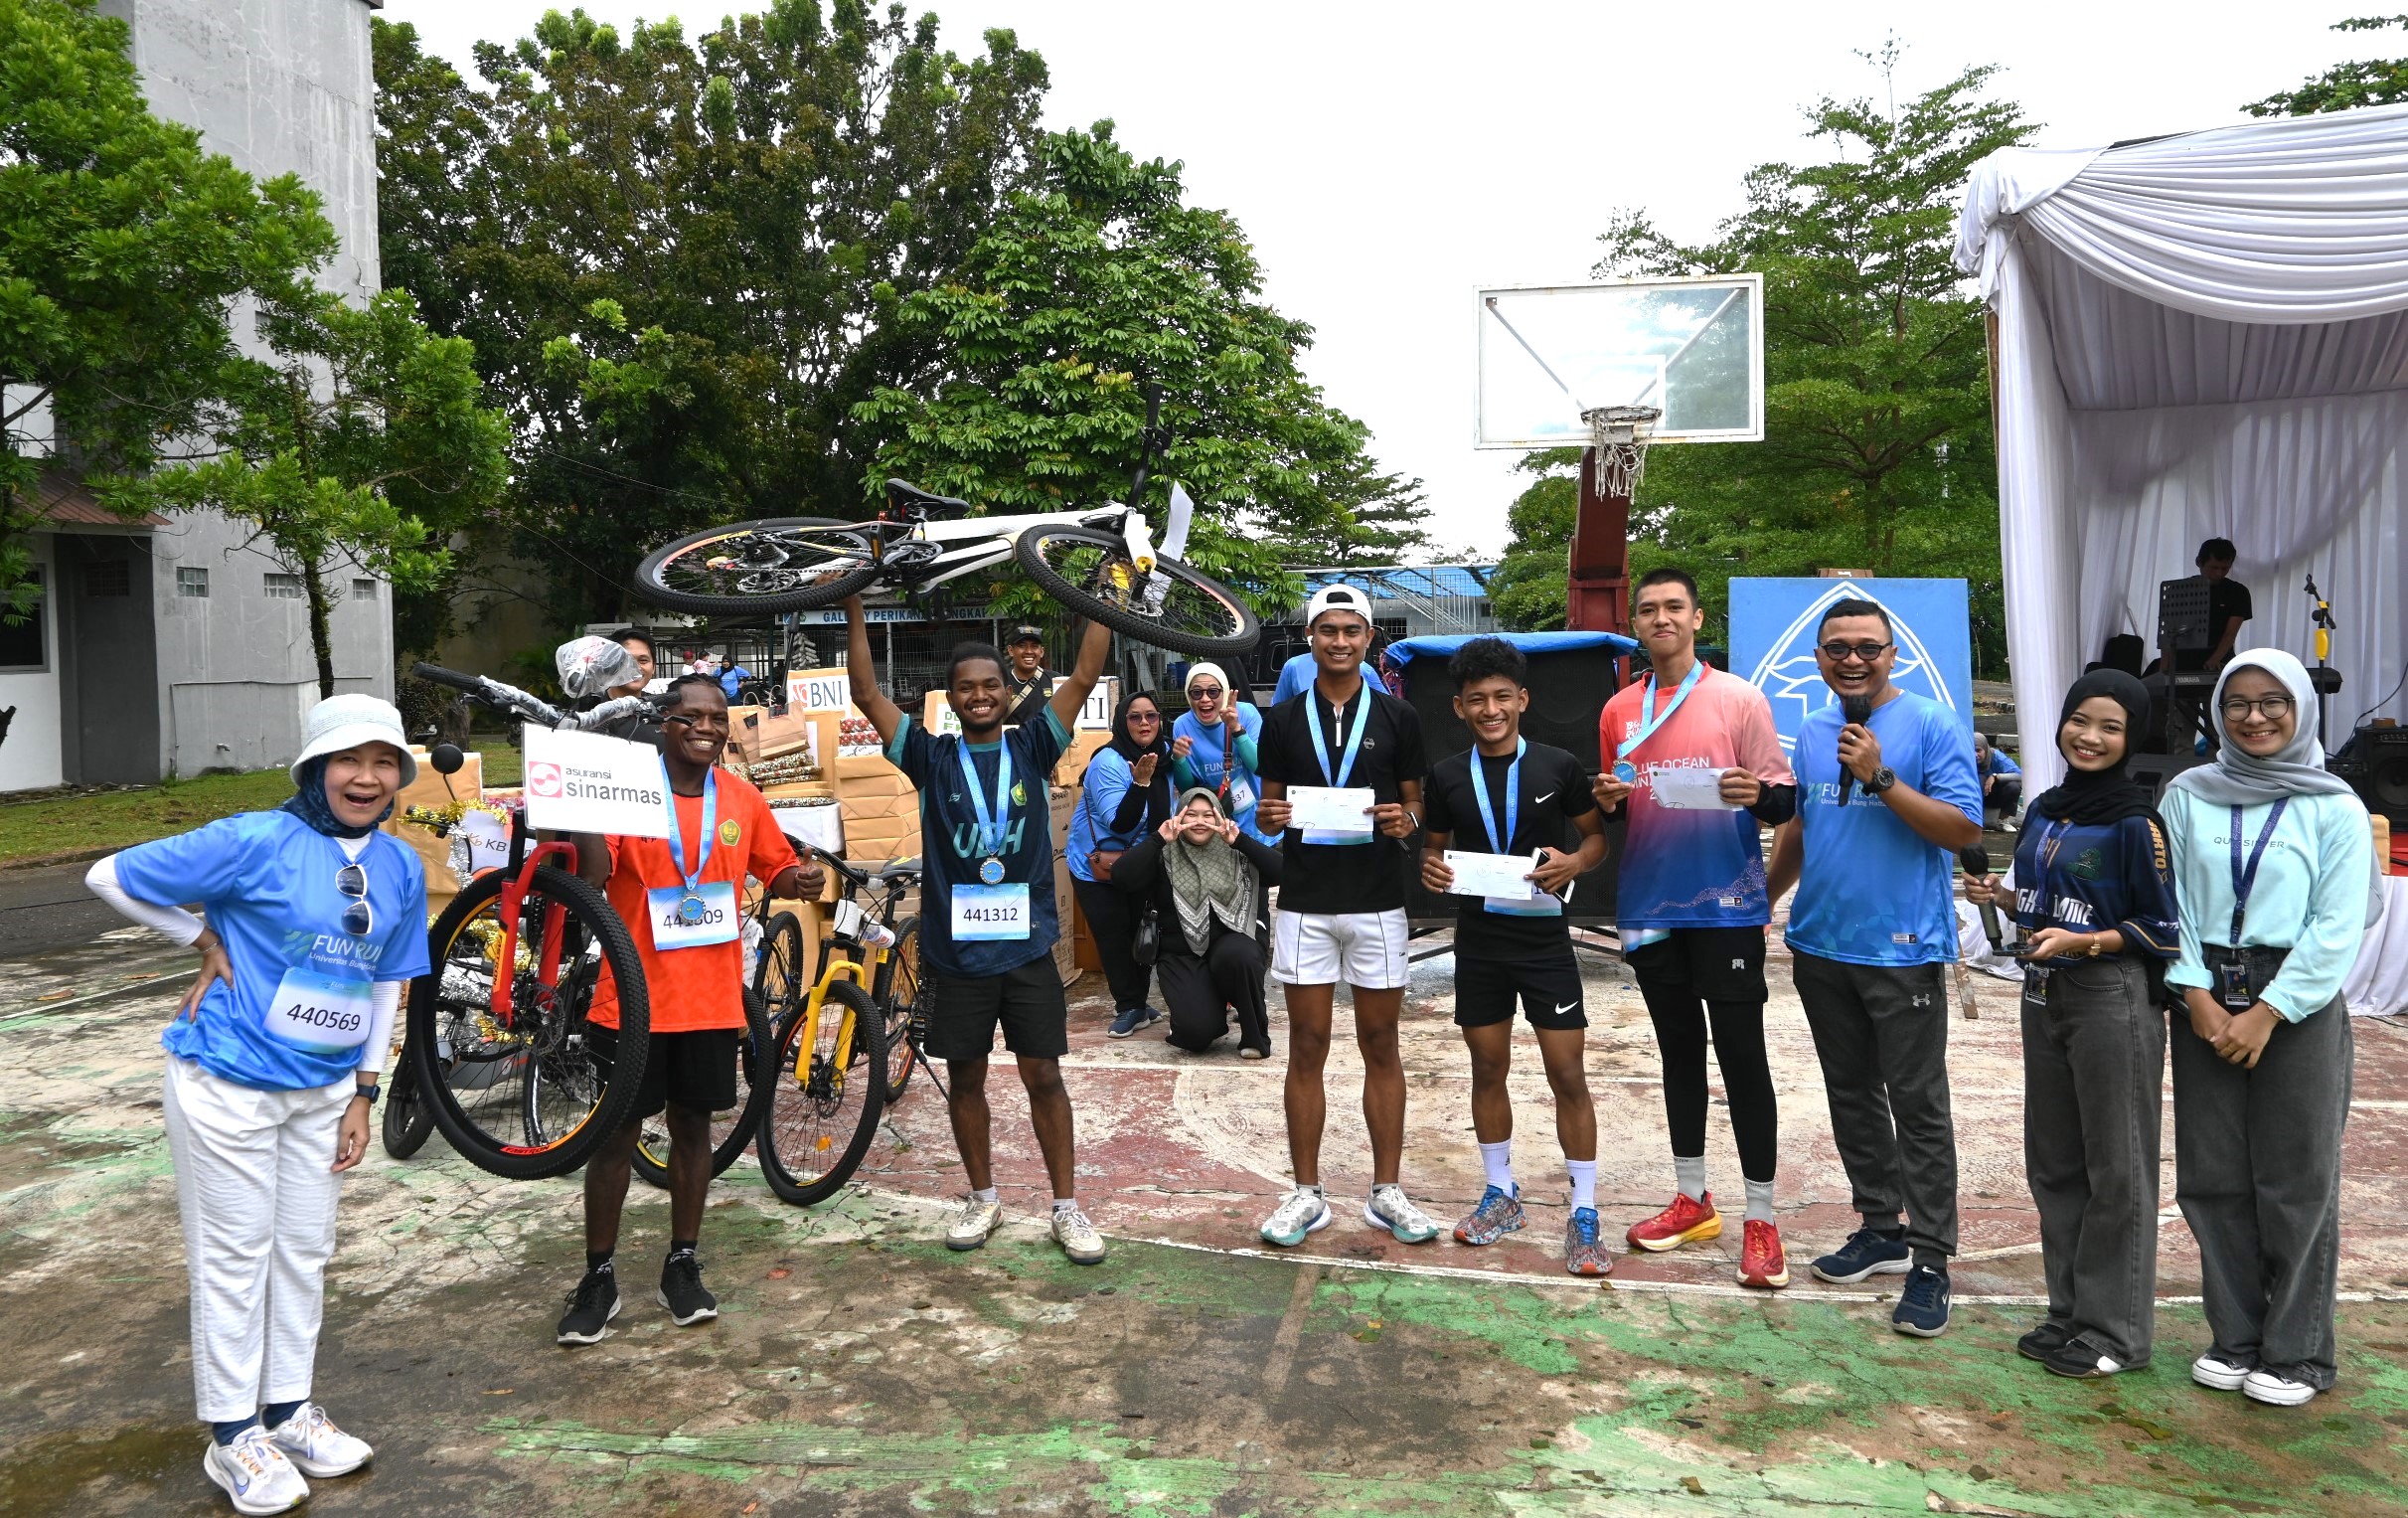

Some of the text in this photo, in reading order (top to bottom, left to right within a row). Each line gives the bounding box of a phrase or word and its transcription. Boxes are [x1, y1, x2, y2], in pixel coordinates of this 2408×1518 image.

[810, 680, 844, 708] BNI
[1662, 757, 1709, 769] OCEAN
[565, 767, 612, 779] asuransi
[565, 778, 662, 805] sinarmas
[1822, 782, 1842, 797] FU
[485, 838, 508, 852] KB
[2213, 836, 2285, 849] QUSIER
[963, 907, 1019, 922] 441312
[312, 934, 354, 956] FUN
[286, 1004, 361, 1031] 440569
